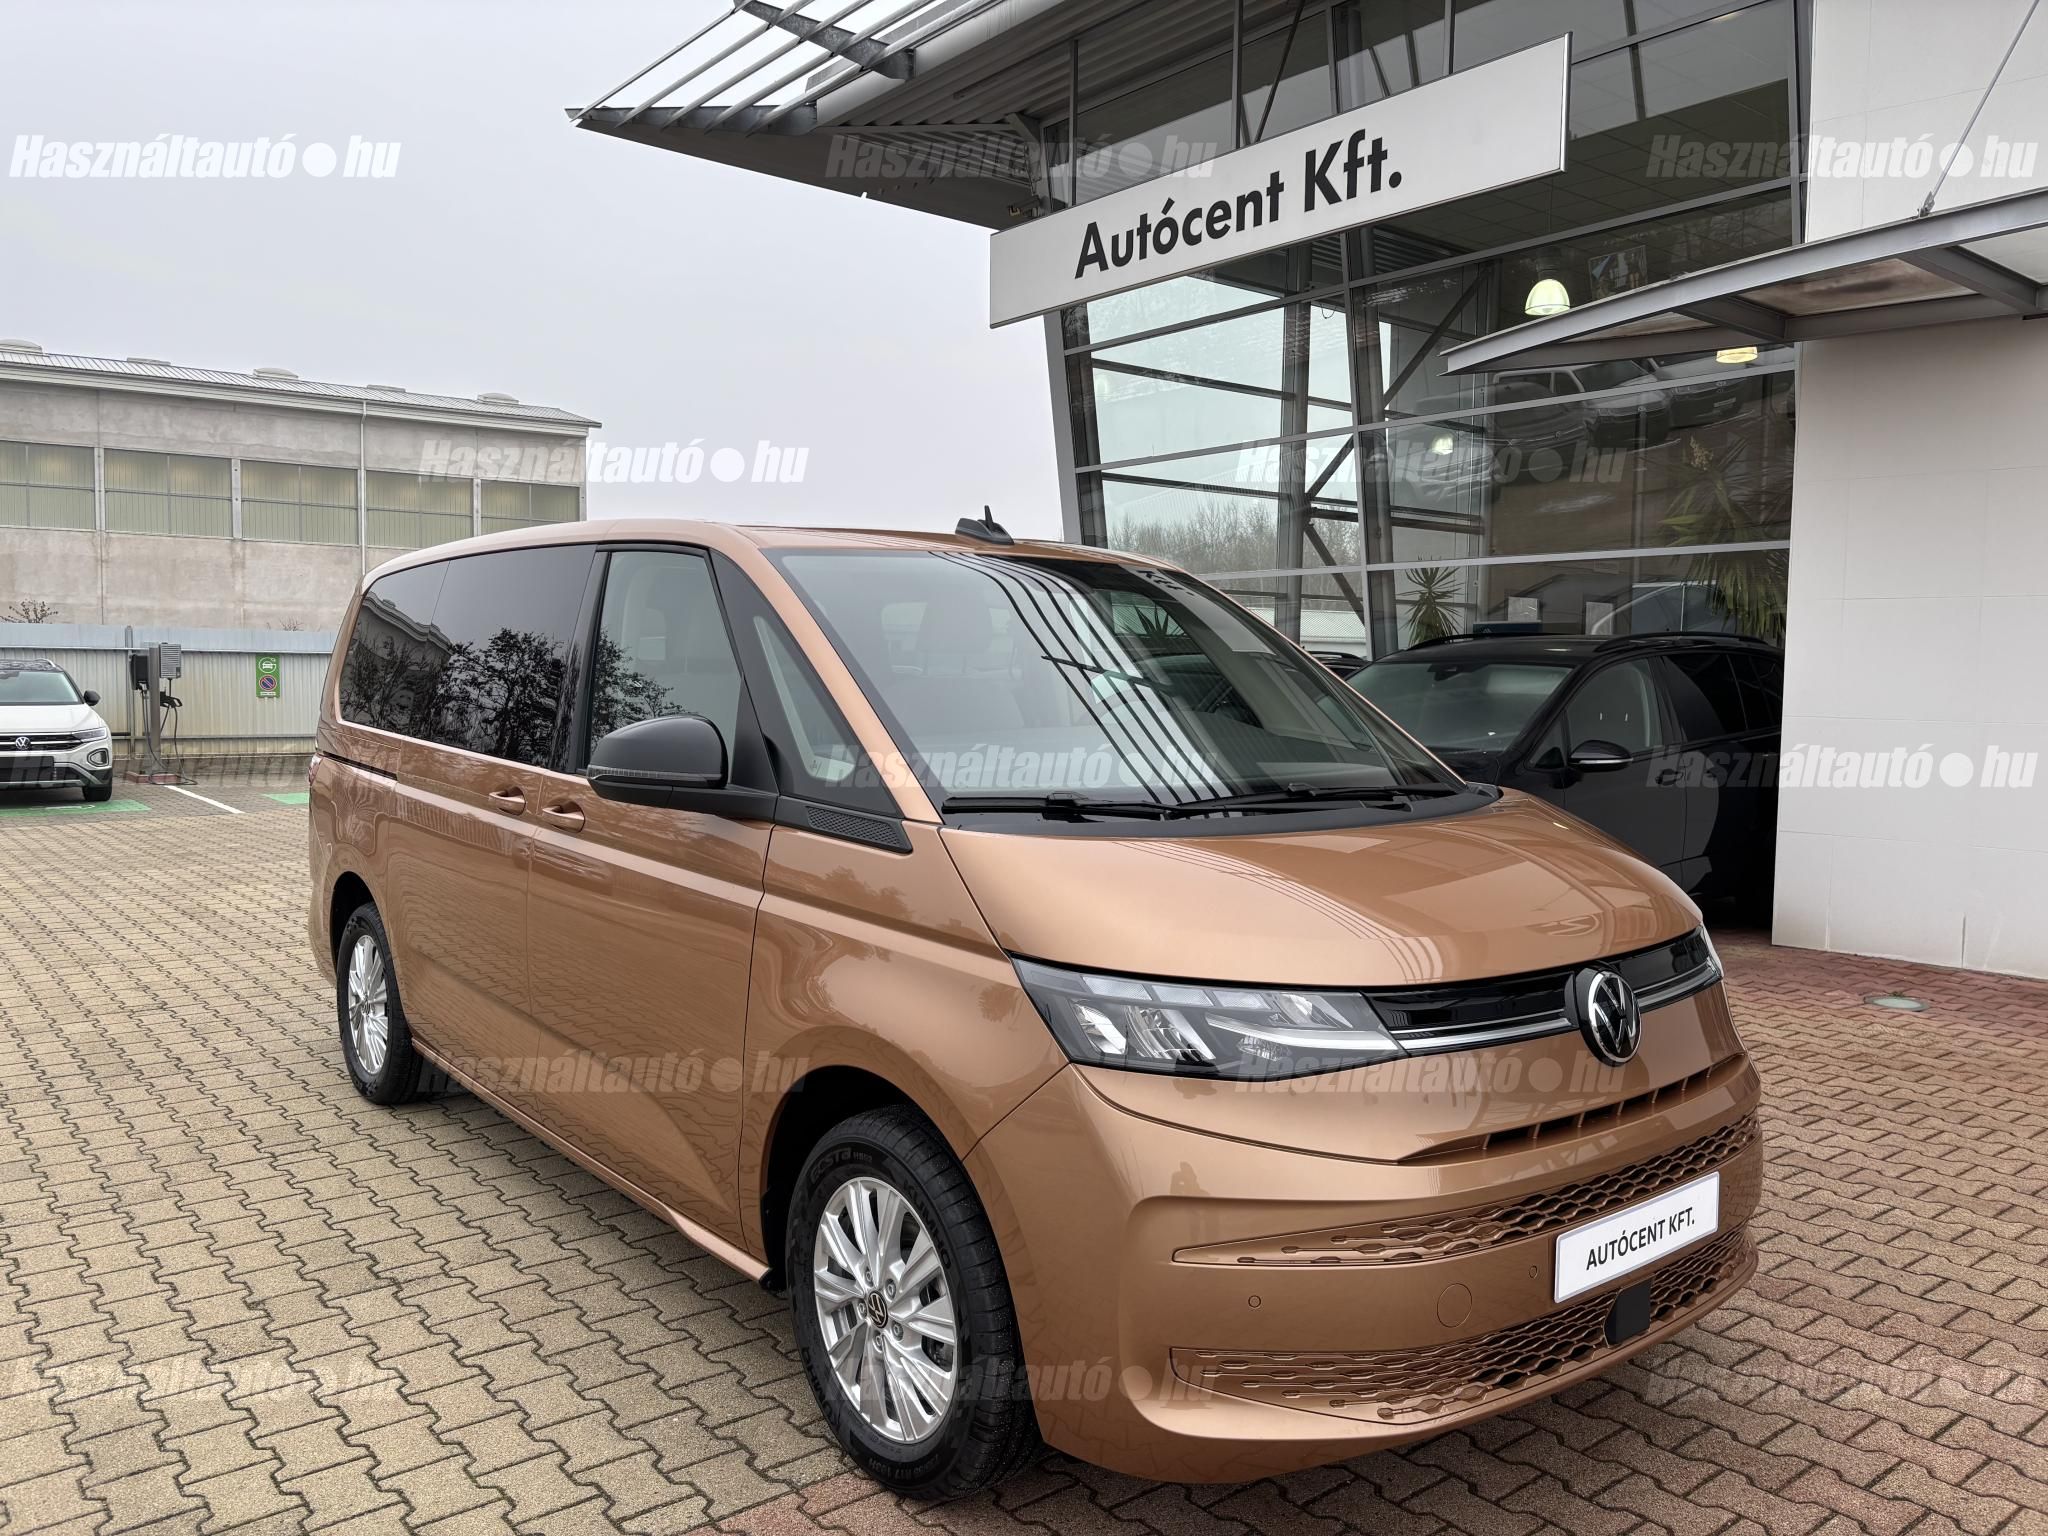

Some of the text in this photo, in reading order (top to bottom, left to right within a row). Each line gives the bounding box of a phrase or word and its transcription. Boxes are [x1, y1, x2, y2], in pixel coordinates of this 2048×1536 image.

[1075, 128, 1402, 280] Autócent Kft.
[1586, 1207, 1695, 1270] AUTÓCENT KFT.
